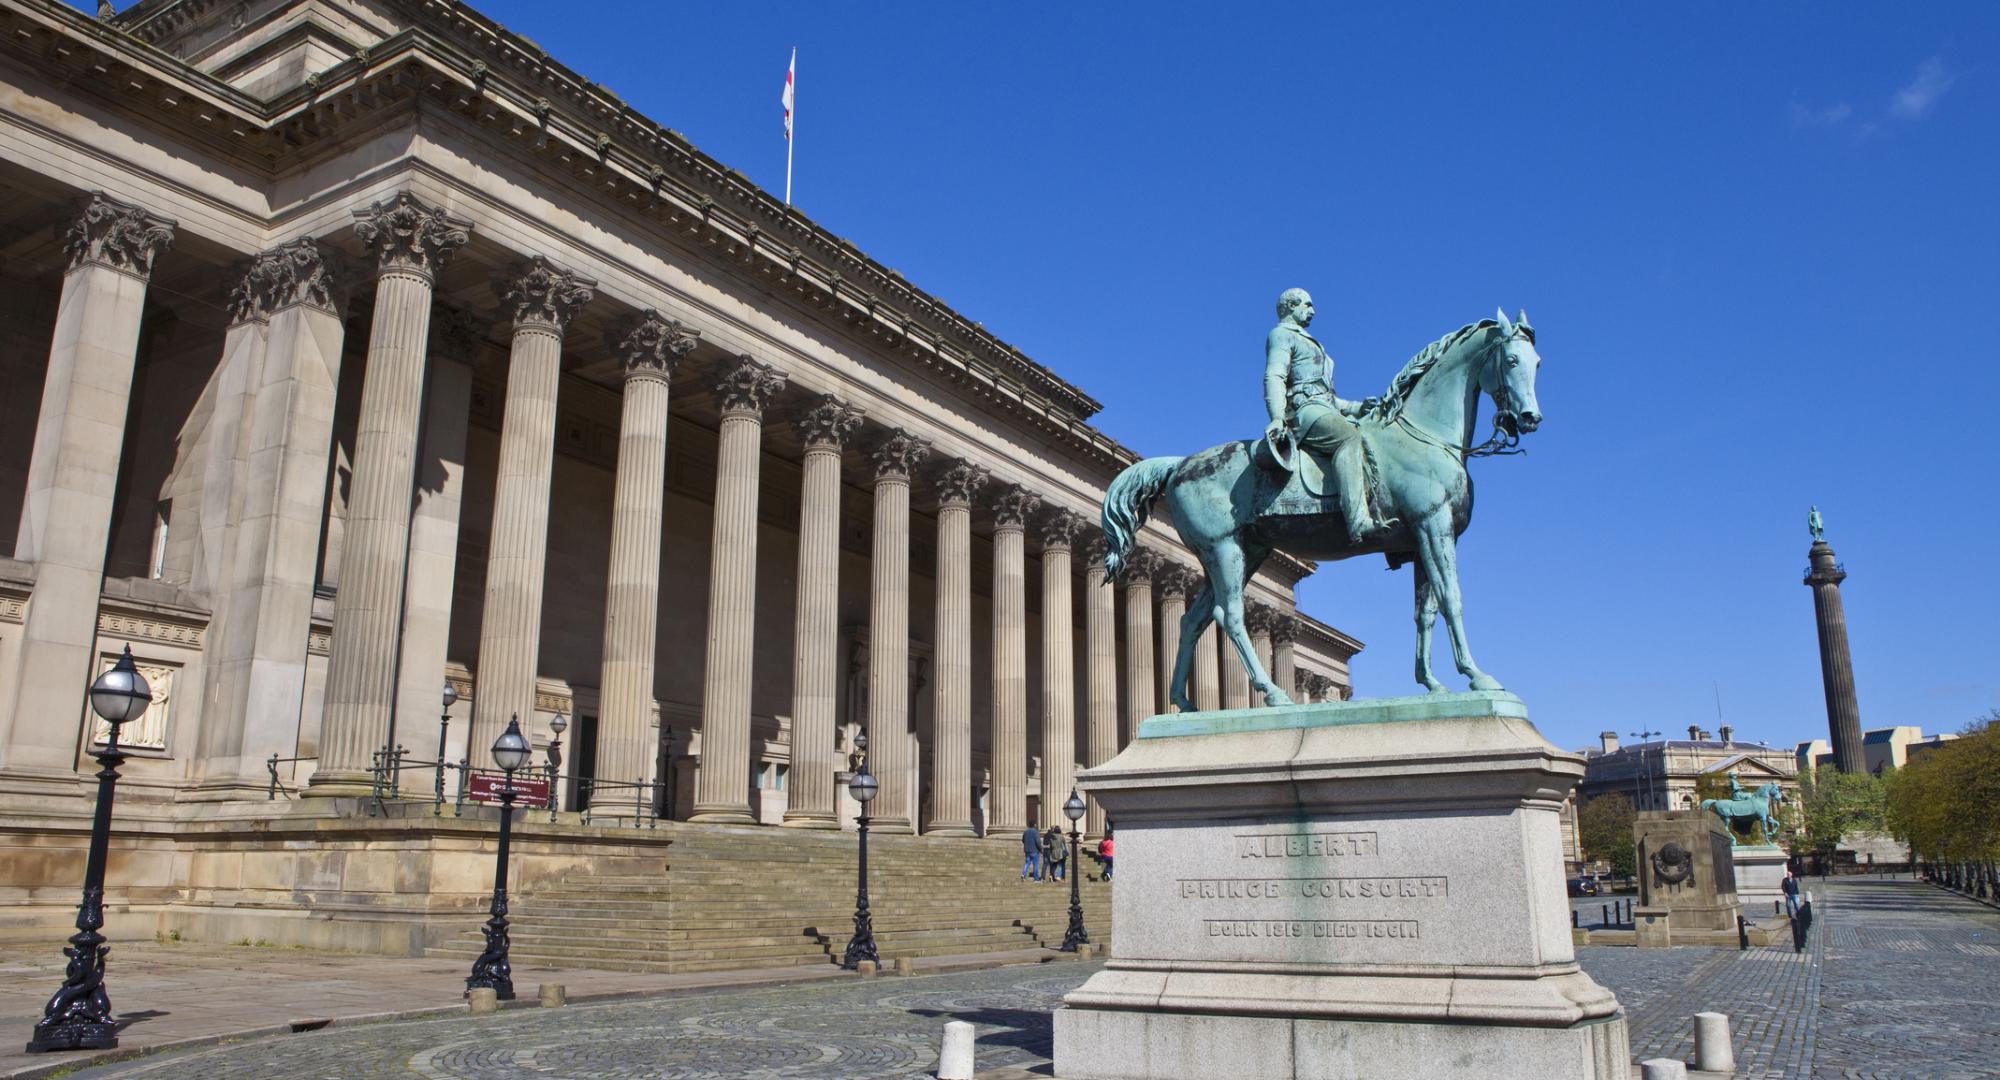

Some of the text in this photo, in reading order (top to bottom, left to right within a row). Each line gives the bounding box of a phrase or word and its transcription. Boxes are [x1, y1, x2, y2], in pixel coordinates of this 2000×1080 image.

[1240, 834, 1370, 858] ALBERT
[1181, 878, 1439, 899] PRINCE CONSORT
[1209, 922, 1259, 937] BORN
[1265, 922, 1304, 938] 1819
[1313, 922, 1358, 938] DIED
